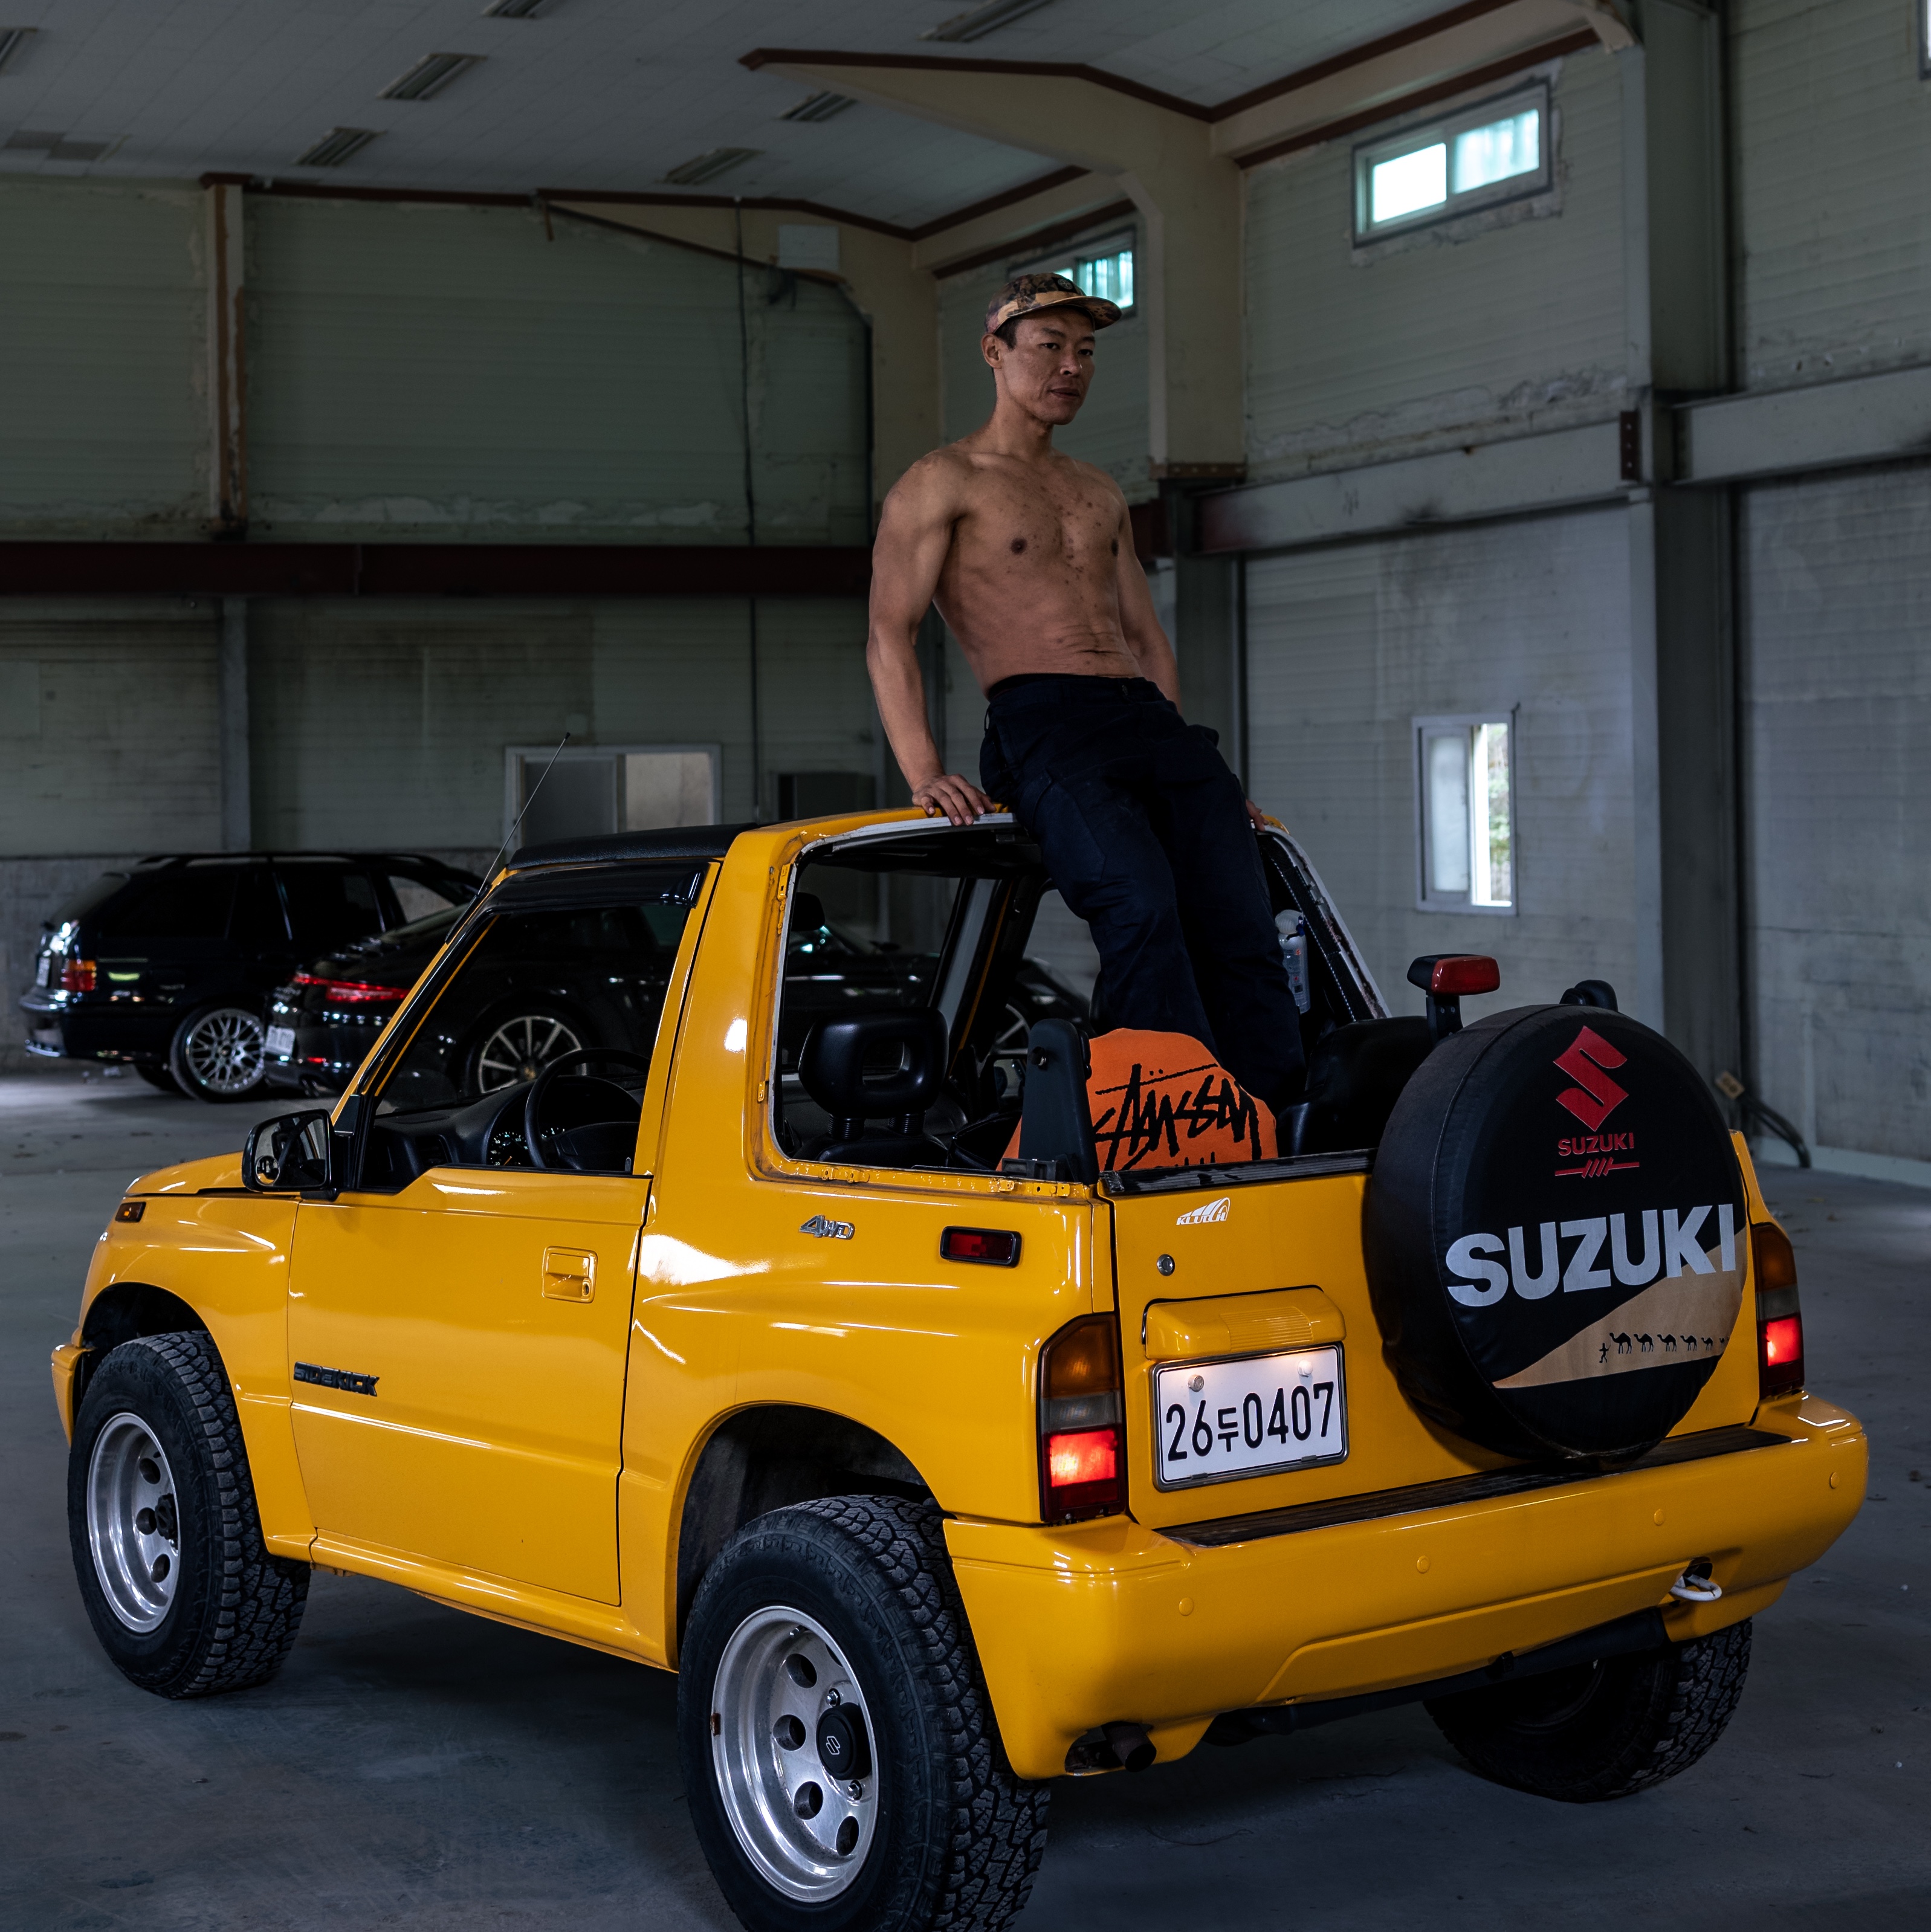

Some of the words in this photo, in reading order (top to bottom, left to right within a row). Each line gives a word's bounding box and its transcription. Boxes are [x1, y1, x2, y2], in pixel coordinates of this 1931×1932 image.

[1558, 1132, 1634, 1156] SUZUKI
[799, 1215, 855, 1239] 4WD
[1446, 1203, 1736, 1307] SUZUKI
[293, 1361, 380, 1397] SIDEKICK
